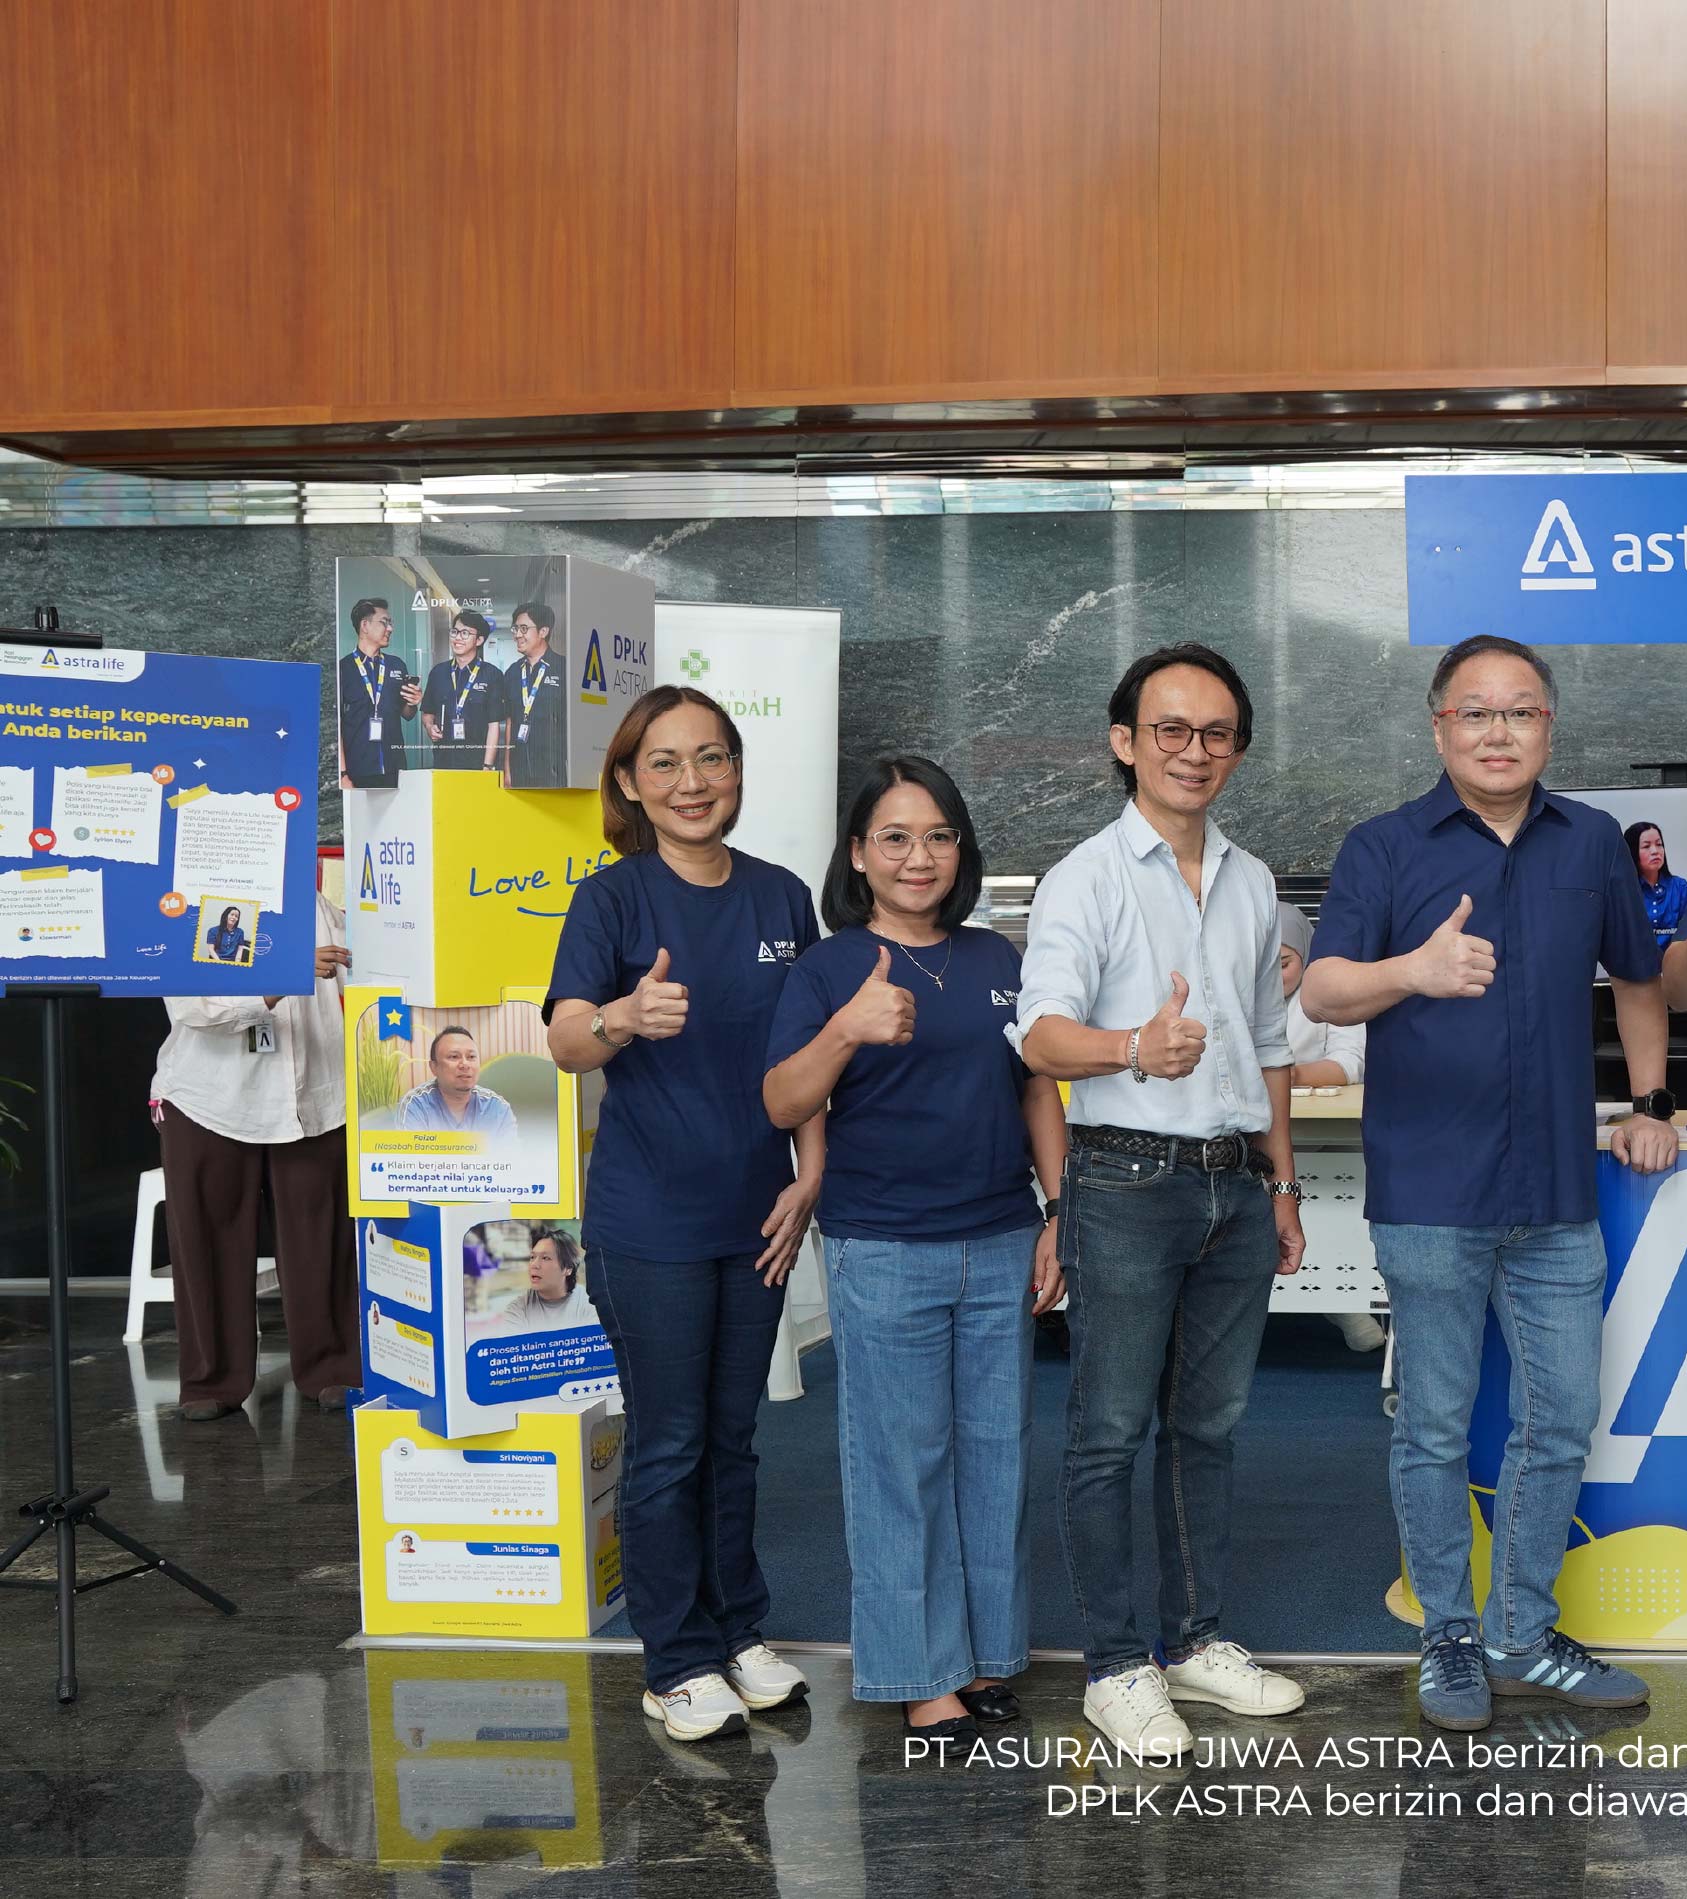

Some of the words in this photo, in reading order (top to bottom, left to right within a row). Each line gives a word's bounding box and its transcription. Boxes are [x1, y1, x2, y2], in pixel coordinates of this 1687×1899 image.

[430, 598, 460, 608] DPLK
[462, 598, 494, 607] ASTRA
[613, 634, 647, 666] DPLK
[63, 657, 100, 669] astra
[102, 657, 125, 670] life
[613, 669, 648, 697] ASTRA
[49, 704, 116, 723] setiap
[121, 708, 249, 729] kepercayaan
[3, 721, 62, 738] Anda
[67, 724, 147, 743] berikan
[379, 836, 415, 866] astra
[469, 867, 550, 897] Love
[565, 850, 611, 886] Lif
[380, 873, 401, 906] life
[154, 943, 167, 951] Life
[773, 941, 797, 950] DPLK
[387, 1161, 416, 1170] Klaim
[418, 1161, 458, 1171] berjalan
[460, 1161, 490, 1170] lancar
[492, 1161, 512, 1170] dan
[387, 1173, 441, 1183] mendapat
[443, 1173, 465, 1182] nilai
[467, 1174, 493, 1184] yang
[388, 1184, 448, 1194] bermanfaat
[450, 1184, 481, 1194] untuk
[484, 1185, 529, 1196] keluarga
[521, 1342, 547, 1351] klaim
[548, 1337, 580, 1348] sangat
[580, 1334, 608, 1344] gamp
[489, 1358, 508, 1367] dan
[509, 1350, 555, 1364] ditangani
[557, 1344, 592, 1357] dengan
[593, 1342, 613, 1351] baik
[489, 1368, 511, 1377] oleh
[512, 1364, 529, 1373] tim
[530, 1361, 556, 1371] Astra
[400, 1446, 408, 1456] S
[499, 1454, 511, 1462] Sri
[511, 1454, 545, 1464] Noviyani
[492, 1545, 520, 1553] Junias
[521, 1545, 550, 1555] Sinaga
